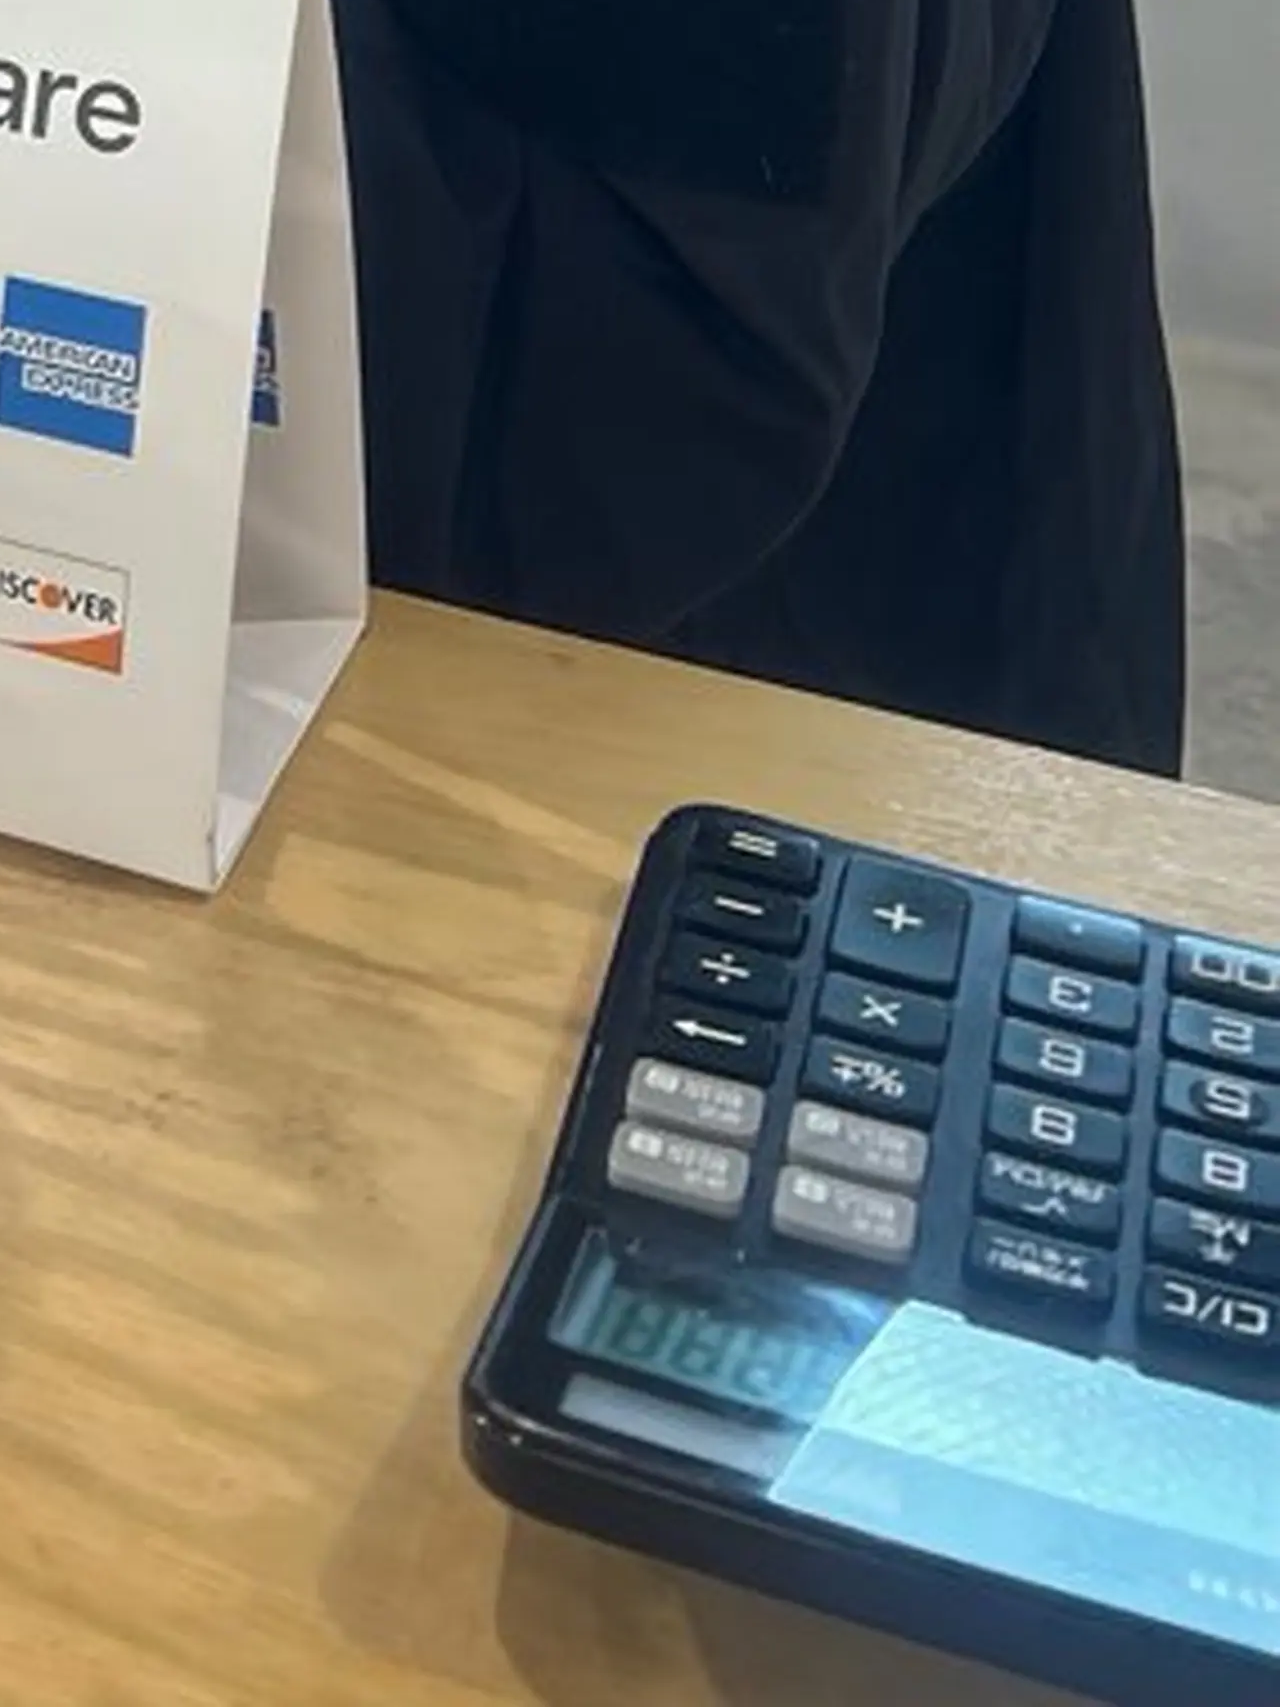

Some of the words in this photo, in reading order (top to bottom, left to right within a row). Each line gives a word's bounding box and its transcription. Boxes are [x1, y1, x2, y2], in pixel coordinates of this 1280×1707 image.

[0, 328, 137, 380] AMERICAN
[24, 365, 140, 410] EXPRESS
[1048, 974, 1094, 1012] 3
[1210, 1015, 1255, 1055] 2
[1203, 1079, 1251, 1121] 5
[1201, 1149, 1250, 1192] 8
